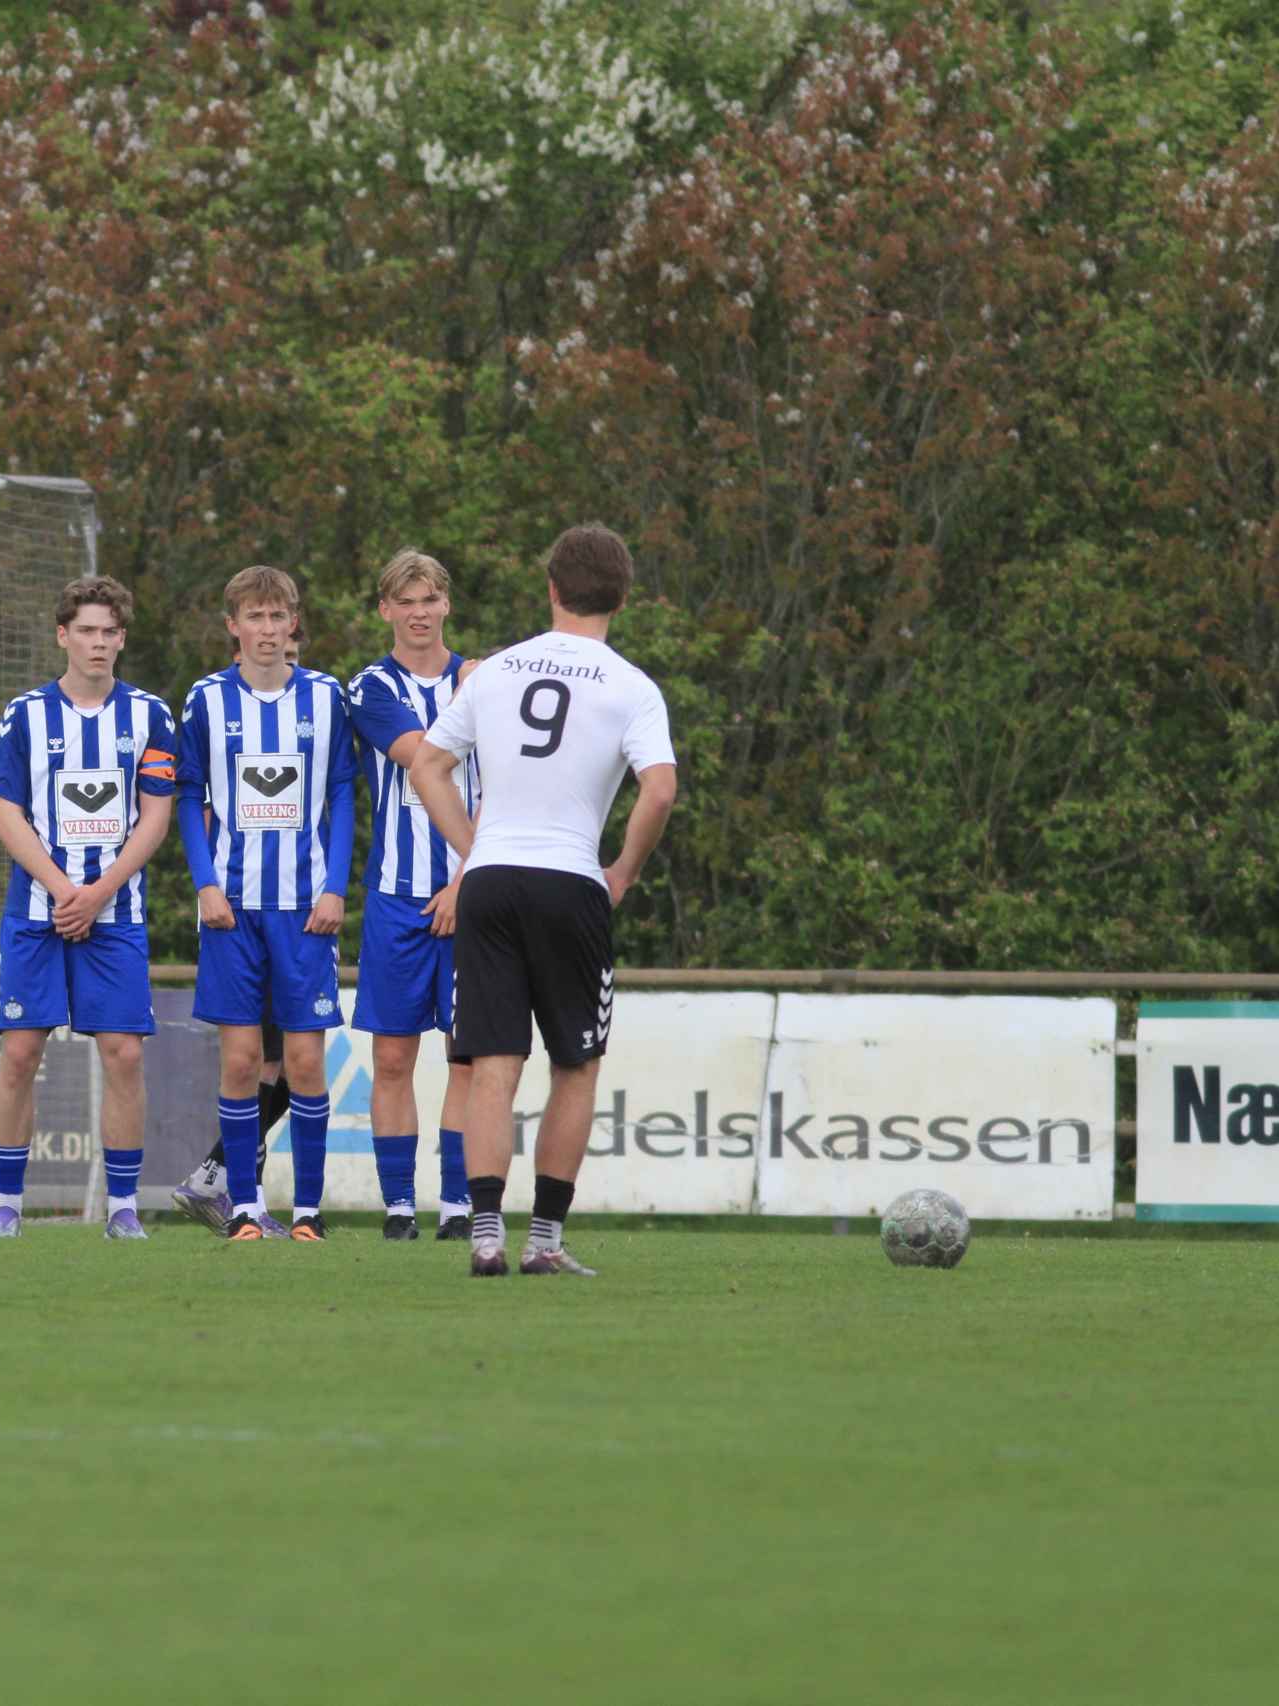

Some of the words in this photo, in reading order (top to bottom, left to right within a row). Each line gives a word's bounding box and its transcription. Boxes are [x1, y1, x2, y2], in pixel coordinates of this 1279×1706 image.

[501, 655, 608, 684] Sydbank
[520, 679, 571, 758] 9
[241, 804, 298, 819] VIKING
[63, 820, 121, 835] VIKING
[434, 1089, 1090, 1164] ndelskassen
